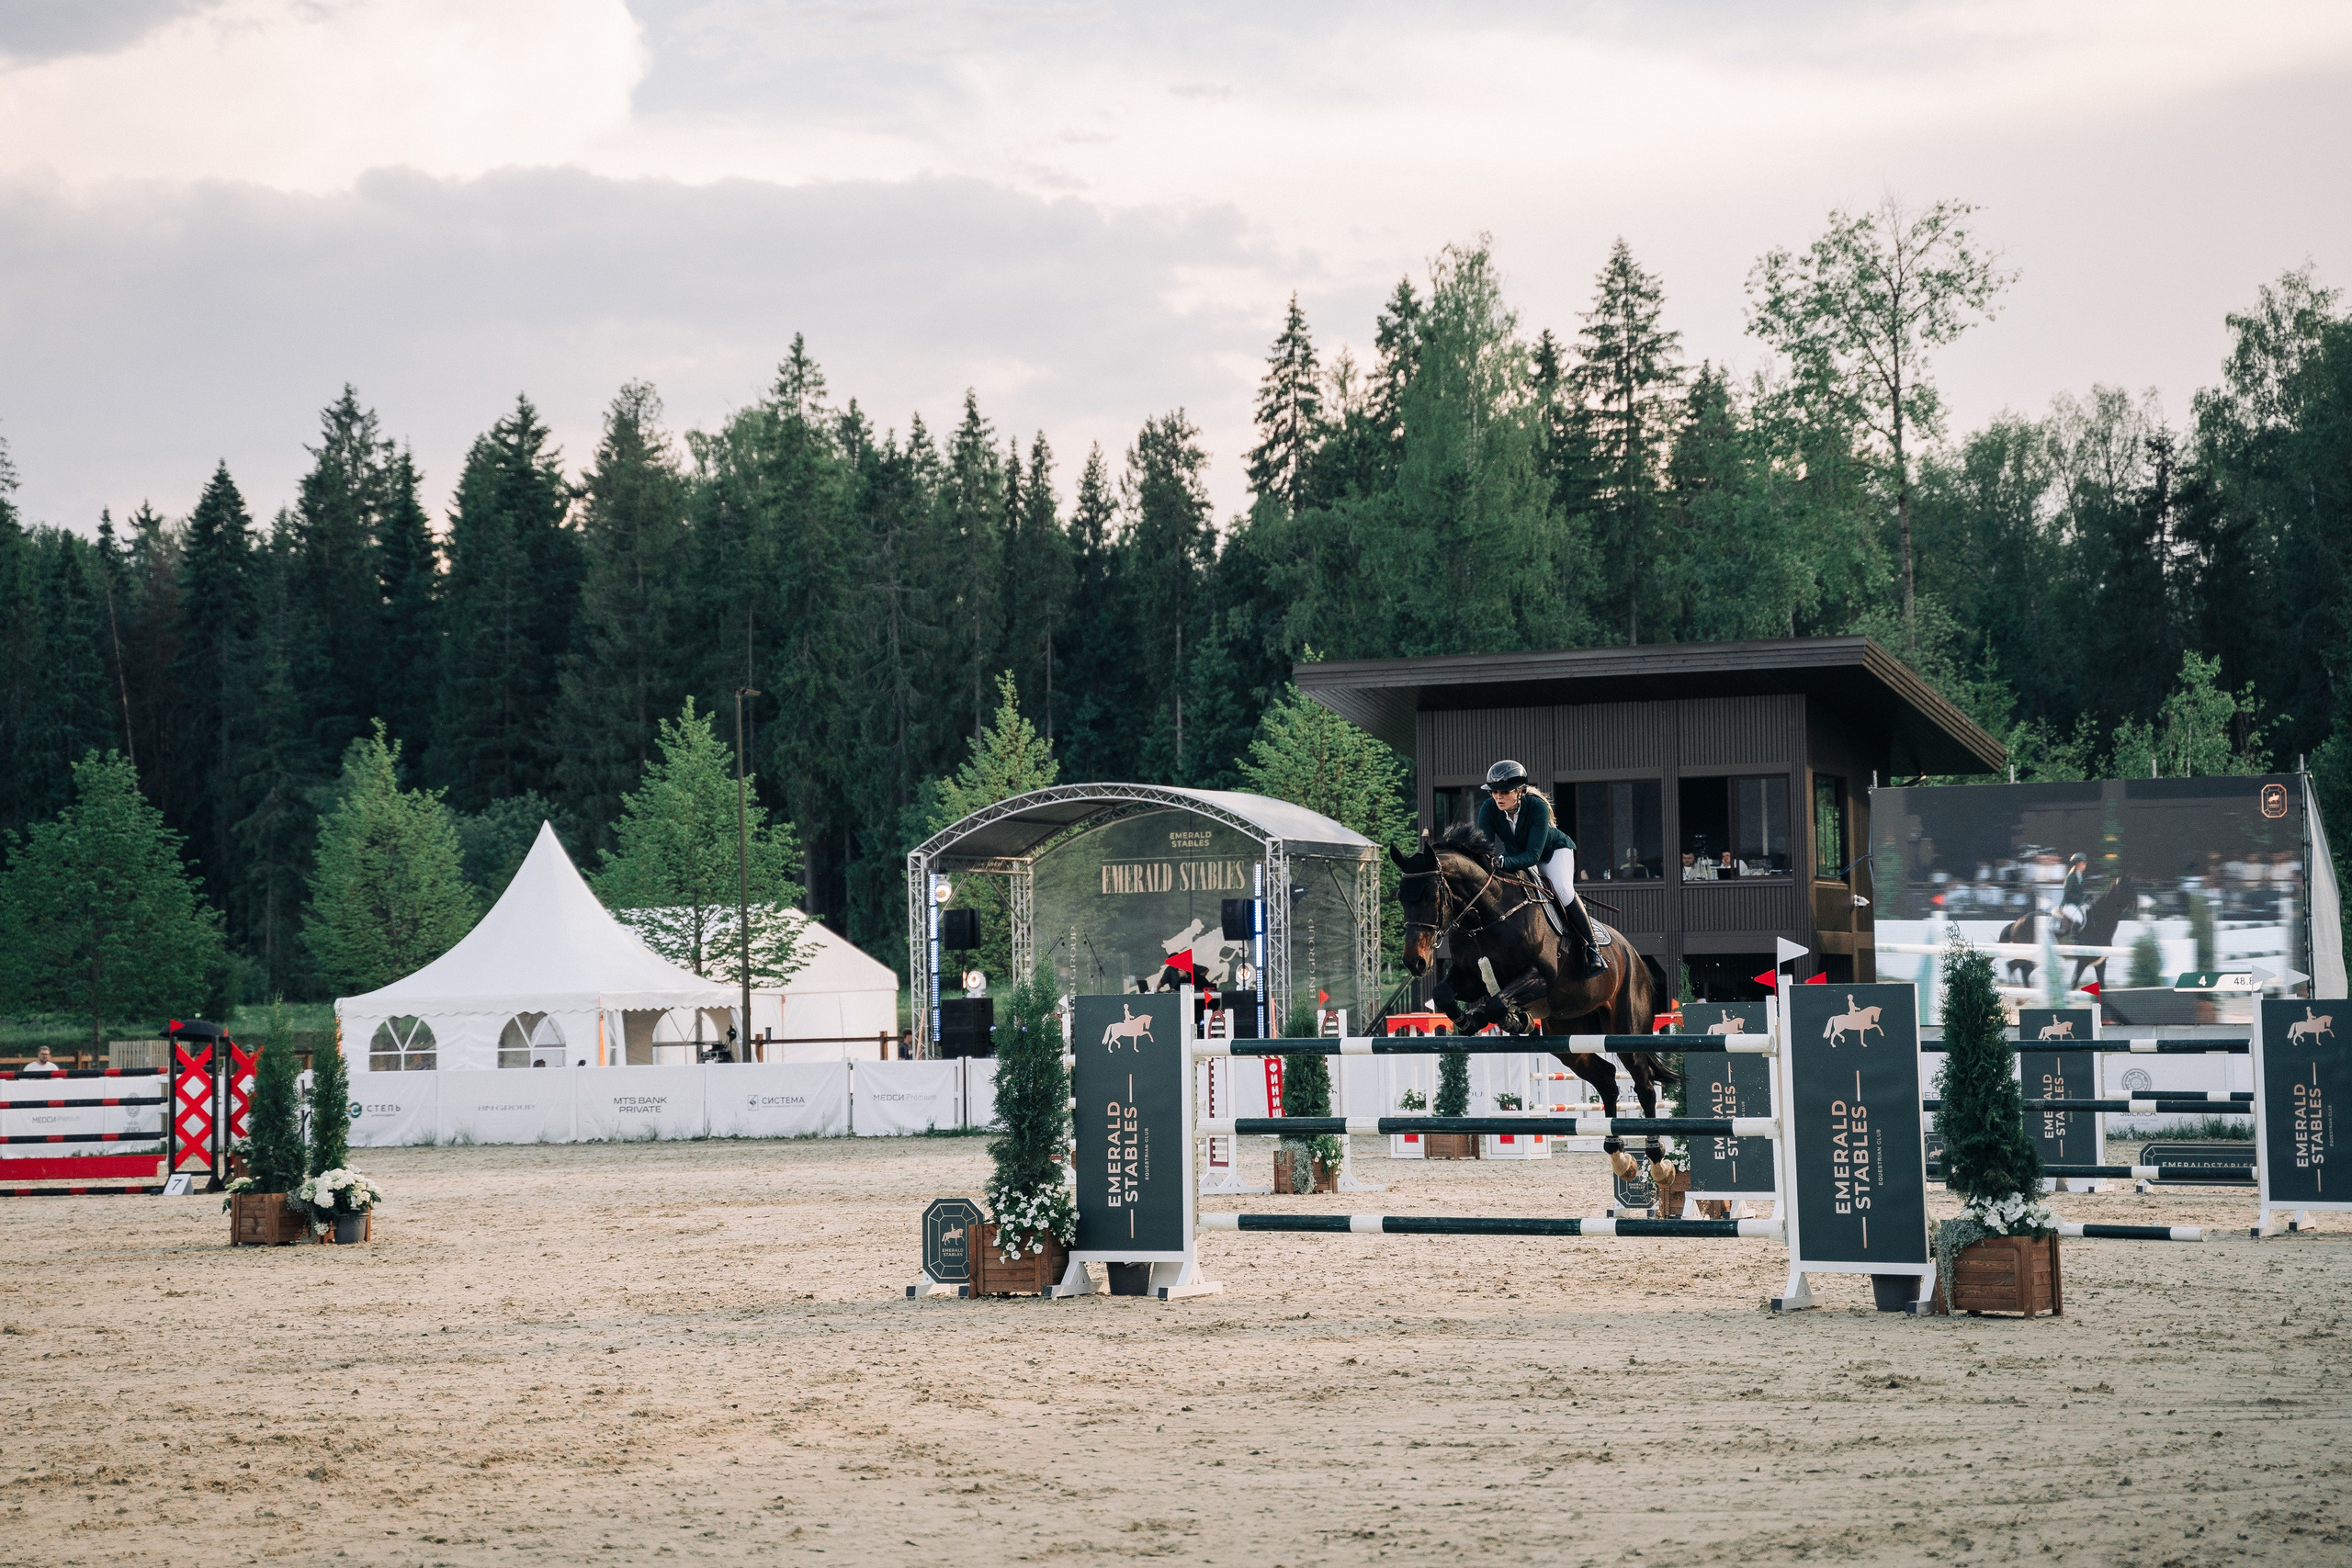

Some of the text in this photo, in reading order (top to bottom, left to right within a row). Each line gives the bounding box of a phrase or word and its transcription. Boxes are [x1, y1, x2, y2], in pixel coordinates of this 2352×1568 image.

[1170, 831, 1212, 840] EMERALD
[1171, 840, 1210, 848] STABLES
[1102, 863, 1172, 895] EMERALD
[1179, 860, 1246, 892] STABLES
[1307, 919, 1316, 974] GROUP
[2198, 975, 2207, 987] 4
[367, 1104, 401, 1112] СТЕПЬ
[618, 1105, 662, 1113] PRIVATE
[639, 1096, 667, 1104] BANK
[762, 1096, 805, 1104] СИСТЕМА
[2293, 1084, 2309, 1168] EMERALD
[2309, 1088, 2324, 1164] STABLES
[1107, 1101, 1122, 1207] EMERALD
[1124, 1106, 1138, 1202] STABLES
[1831, 1100, 1851, 1213] EMERALD
[1851, 1105, 1871, 1210] STABLES
[172, 1179, 183, 1190] 7
